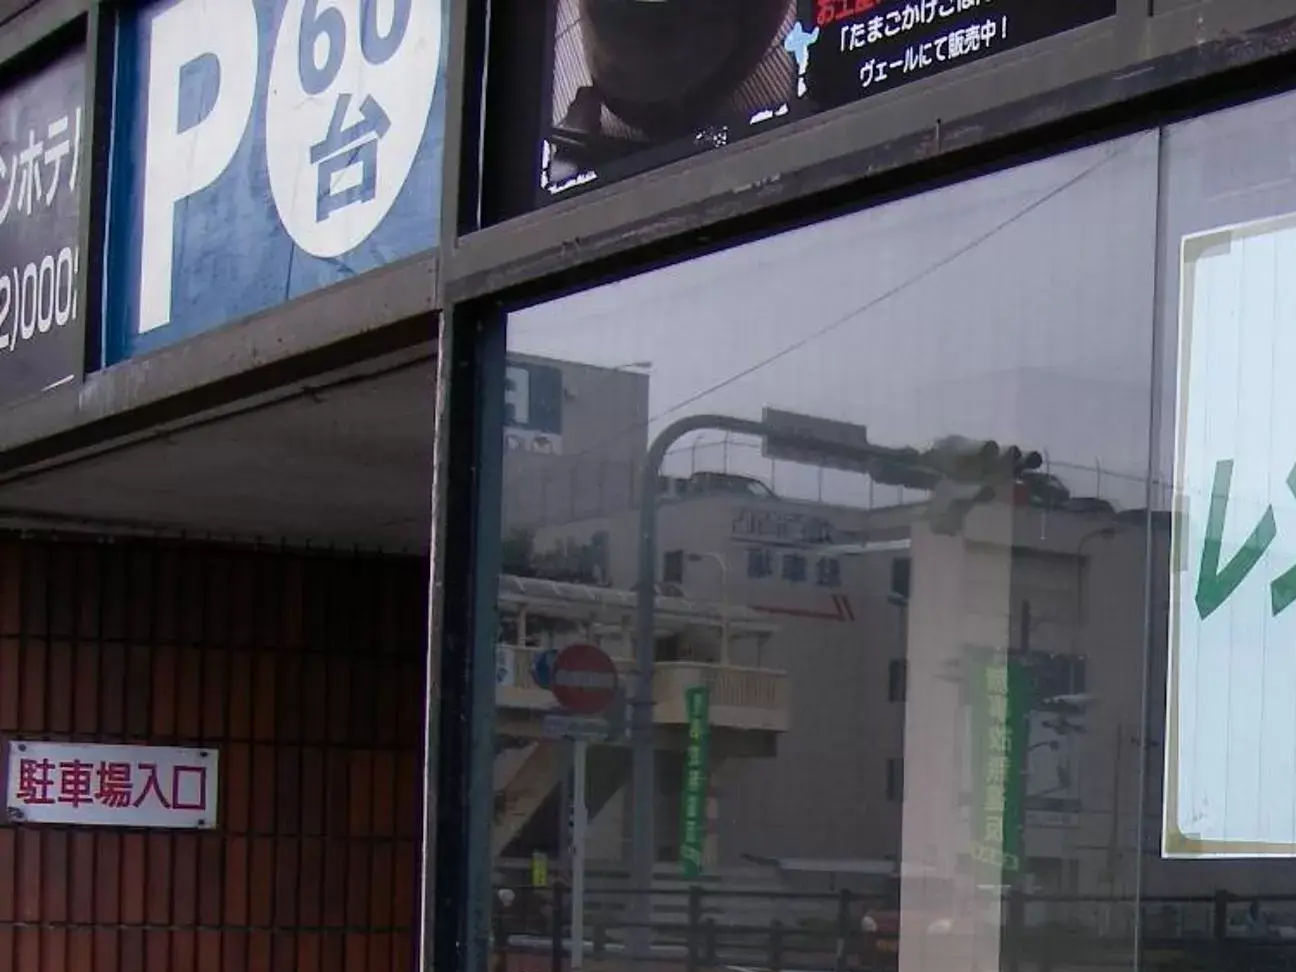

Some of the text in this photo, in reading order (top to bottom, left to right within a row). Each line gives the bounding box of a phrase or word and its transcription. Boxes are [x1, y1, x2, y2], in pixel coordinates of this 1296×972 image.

[860, 16, 1007, 87] ヴェールにて販売中！
[16, 758, 207, 811] 駐車場入口
